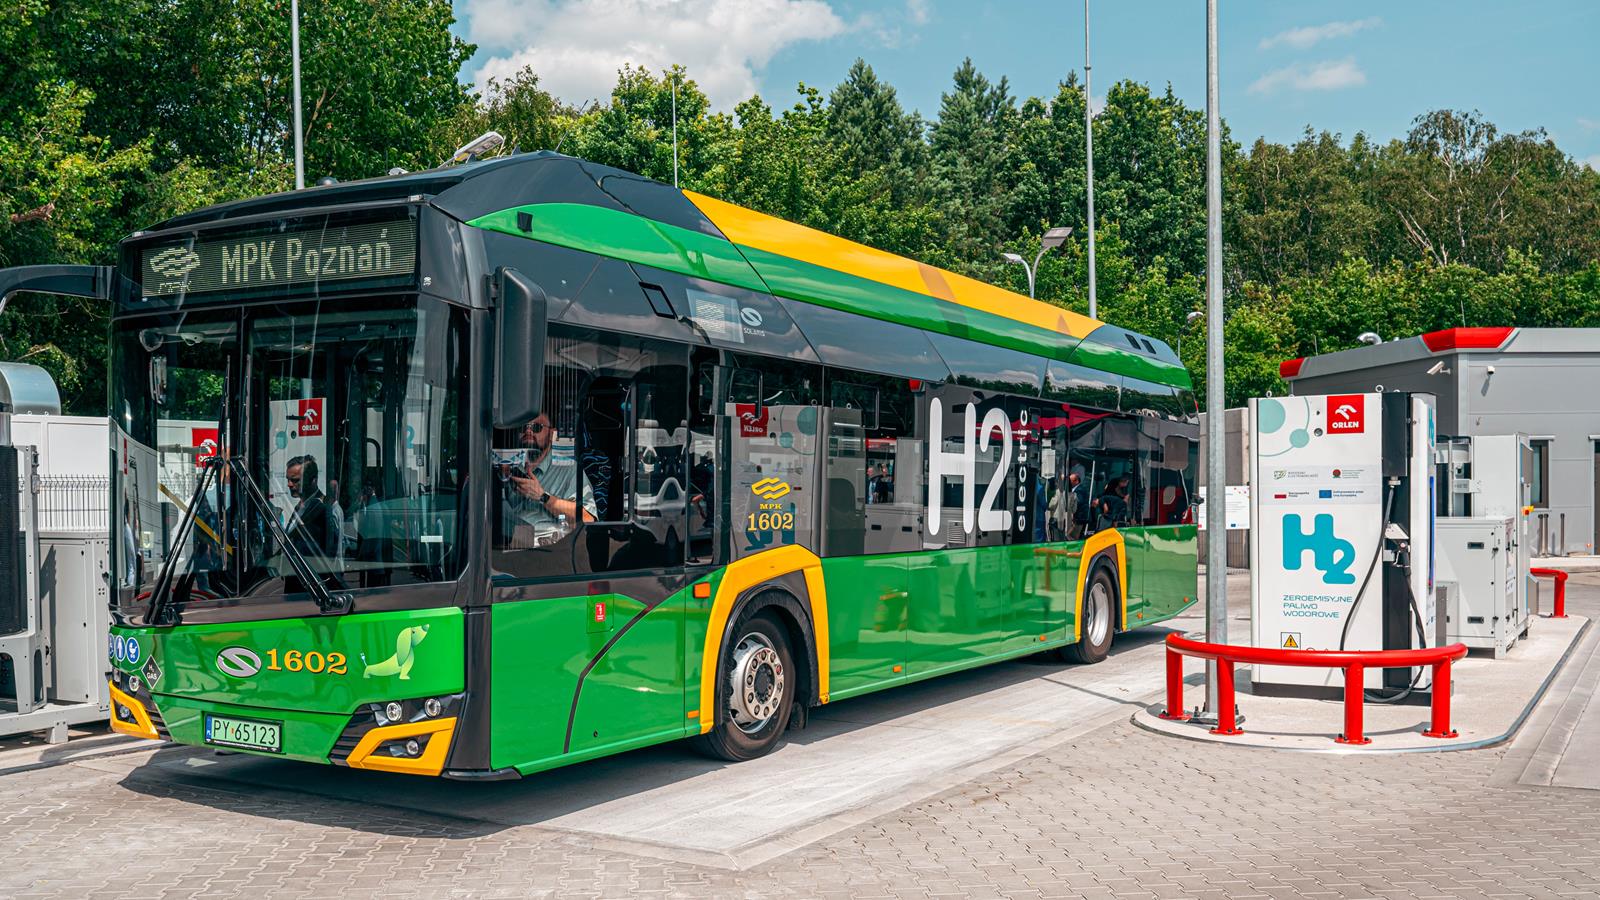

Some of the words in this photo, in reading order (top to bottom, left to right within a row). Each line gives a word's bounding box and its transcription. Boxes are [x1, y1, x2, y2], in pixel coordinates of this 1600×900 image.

[222, 240, 276, 284] MPK
[286, 228, 391, 278] Poznań
[1331, 421, 1360, 429] ORLEN
[928, 397, 1013, 535] H2
[1016, 410, 1028, 532] electric
[748, 512, 793, 531] 1602
[1282, 513, 1356, 584] H2
[1283, 594, 1353, 603] ZEROEMISYJNE
[1283, 610, 1340, 619] WODOROWE
[266, 648, 348, 676] 1602
[146, 672, 158, 680] GAS
[213, 719, 230, 740] PY
[234, 722, 276, 746] 65123
